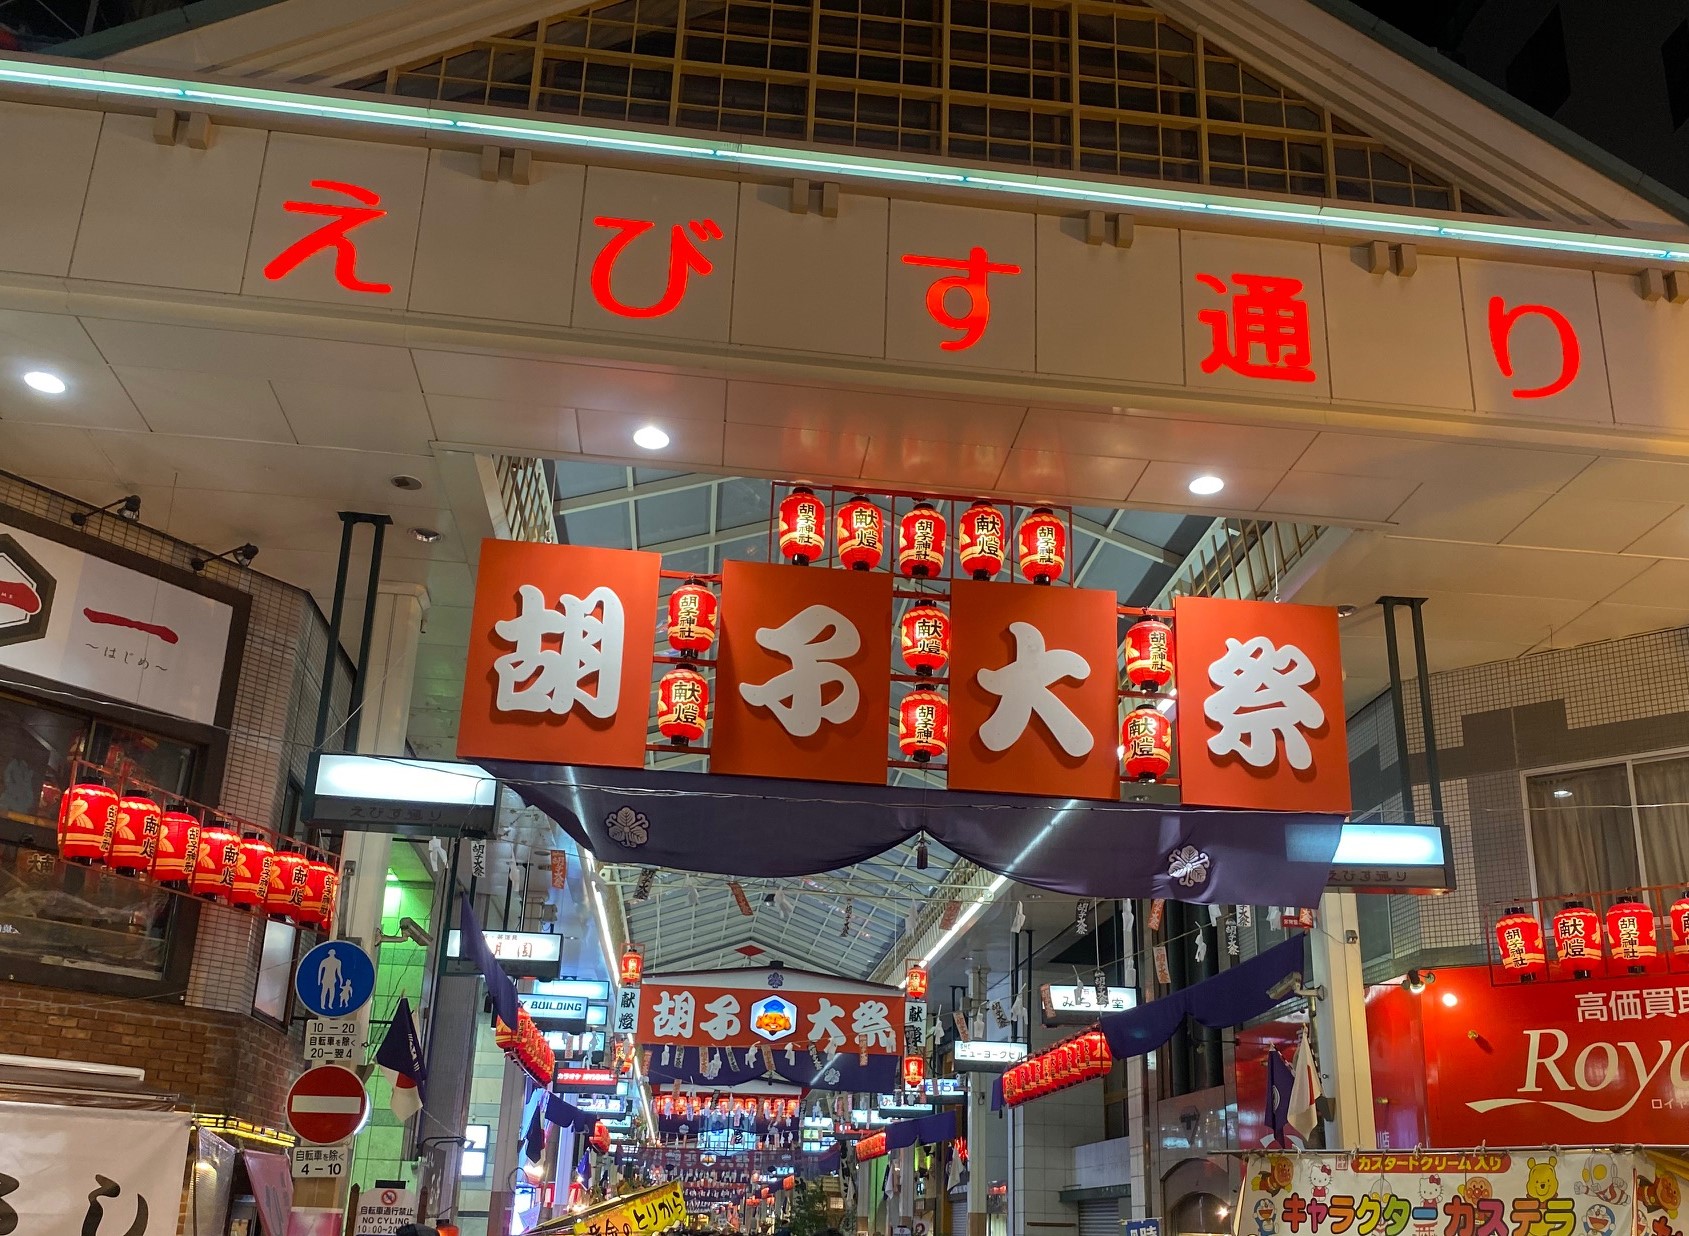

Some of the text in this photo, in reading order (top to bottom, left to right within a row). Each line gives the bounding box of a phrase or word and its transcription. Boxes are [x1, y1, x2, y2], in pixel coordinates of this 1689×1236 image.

[262, 178, 1582, 399] えびす通り
[798, 502, 815, 545] 胡子神社
[853, 507, 879, 550] 献燈
[915, 520, 934, 561] 胡子神社
[976, 514, 1000, 558] 献燈
[1038, 526, 1056, 564] 胡子神社
[680, 596, 698, 639] 胡子神社
[917, 618, 942, 655] 献燈
[1150, 631, 1167, 671] 胡子神社
[493, 583, 1326, 772] 胡子大祭
[673, 681, 701, 725] 献燈
[1129, 717, 1156, 759] 献燈
[1225, 925, 1240, 955] 胡子大祭
[1504, 928, 1528, 967] 胡子神社
[1559, 918, 1586, 958] 献燈
[1618, 917, 1640, 959] 胡子神社
[530, 1000, 582, 1012] BUILDING
[618, 991, 636, 1030] 献燈
[309, 1036, 356, 1047] 自転車を除く
[295, 1149, 345, 1162] 自転車を除く
[360, 1206, 414, 1216] 自転車通行禁止
[377, 1217, 410, 1225] CYLING
